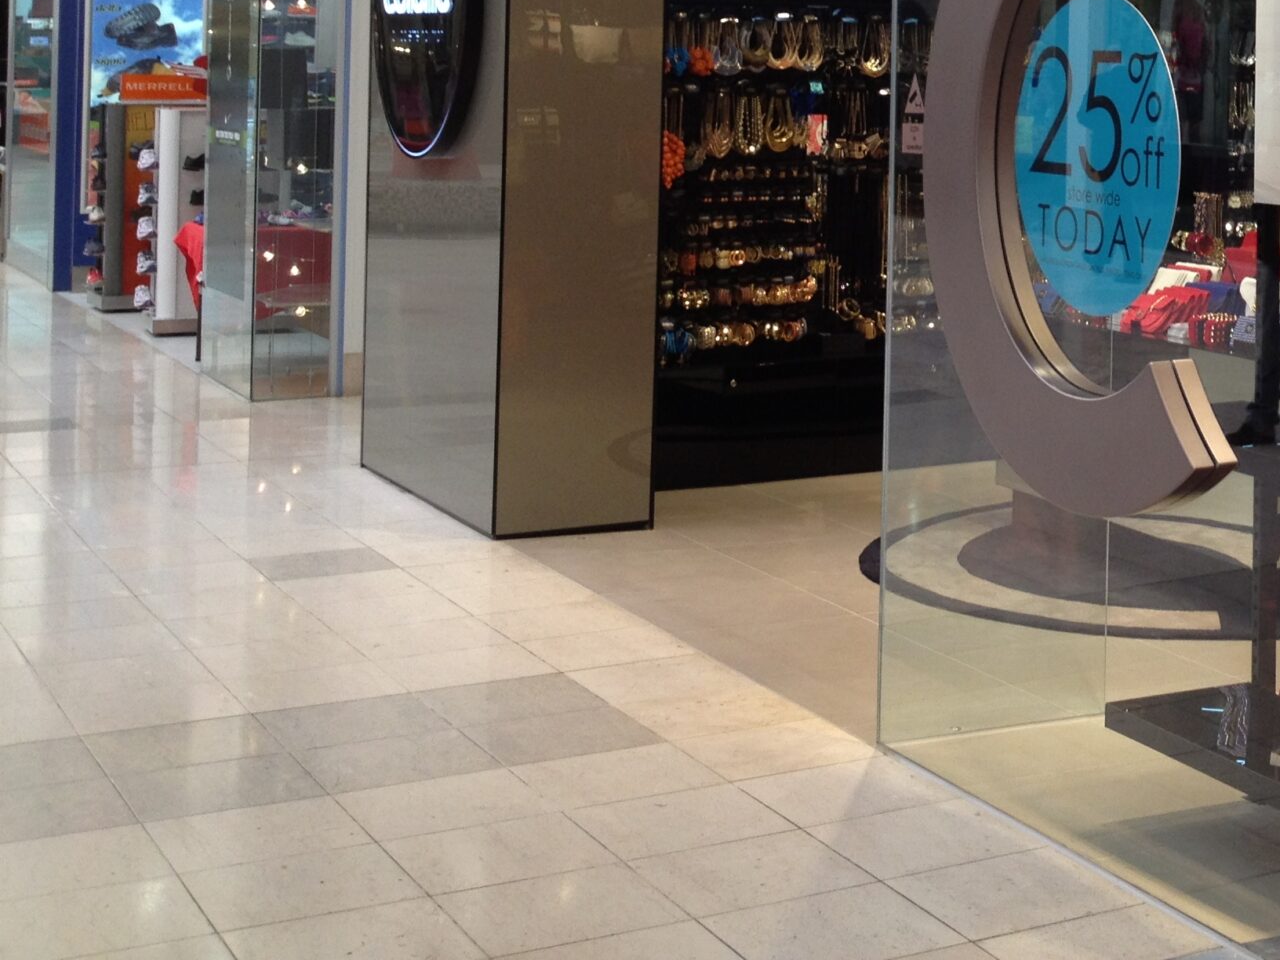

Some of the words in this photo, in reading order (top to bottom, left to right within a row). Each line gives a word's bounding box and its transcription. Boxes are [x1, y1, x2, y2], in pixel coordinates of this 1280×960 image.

[125, 82, 194, 91] MERRELL
[1121, 136, 1165, 189] off
[1095, 189, 1121, 207] wide
[1038, 203, 1152, 263] TODAY
